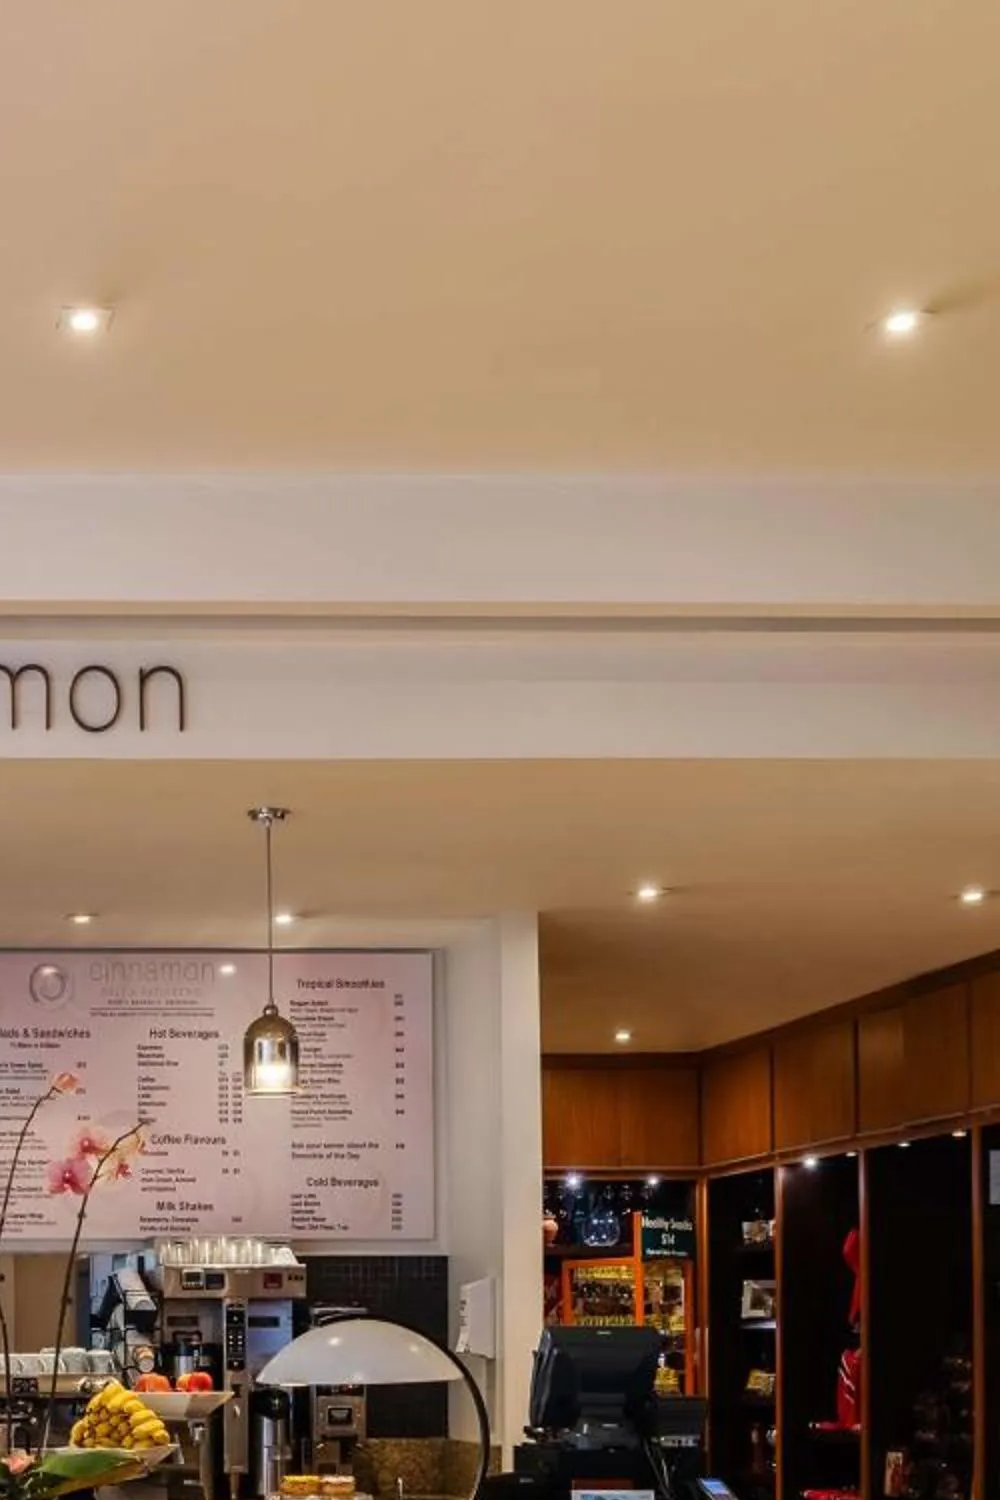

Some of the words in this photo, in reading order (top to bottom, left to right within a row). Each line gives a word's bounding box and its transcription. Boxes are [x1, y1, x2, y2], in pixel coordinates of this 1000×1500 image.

[297, 978, 334, 991] Tropical
[22, 1027, 30, 1039] &
[33, 1027, 91, 1039] Sandwiches
[149, 1028, 167, 1039] Hot
[169, 1028, 219, 1041] Beverages
[151, 1134, 182, 1145] Coffee
[184, 1134, 227, 1145] Flavours
[306, 1177, 329, 1187] Cold
[330, 1177, 379, 1189] Beverages
[179, 1201, 214, 1211] Shakes
